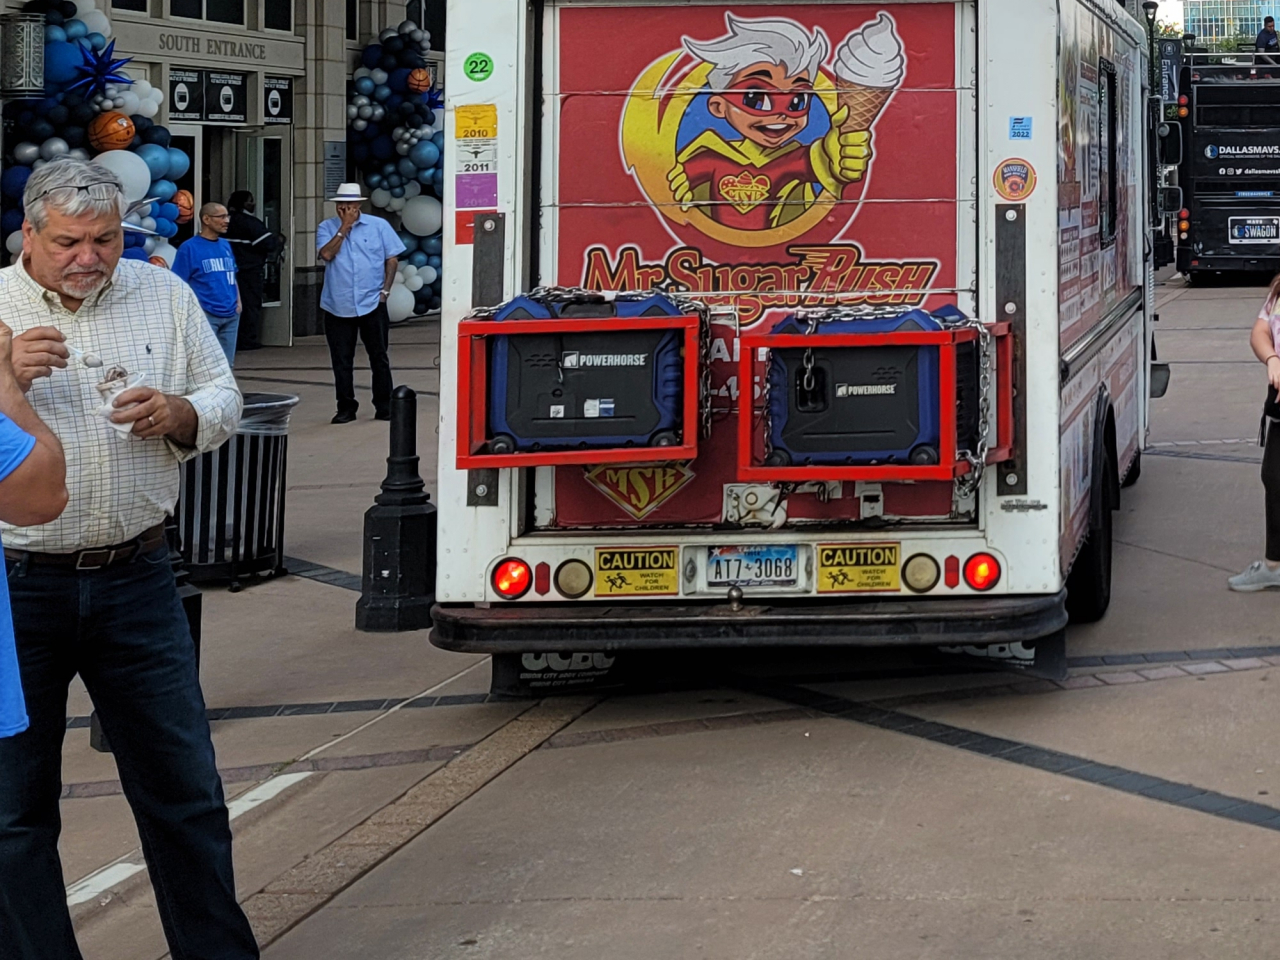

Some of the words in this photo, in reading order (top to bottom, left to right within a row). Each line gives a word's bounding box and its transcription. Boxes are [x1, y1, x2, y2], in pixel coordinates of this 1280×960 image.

[159, 33, 200, 53] SOUTH
[206, 39, 266, 60] ENTRANCE
[469, 59, 489, 74] 22
[1161, 59, 1171, 101] Entrance
[463, 129, 488, 138] 2010
[464, 163, 490, 172] 2011
[1244, 225, 1277, 238] SWAGON
[667, 247, 810, 325] Sugar
[580, 353, 648, 367] POWERHORSE
[848, 383, 897, 395] POWERHORSE
[600, 552, 674, 569] CAUTION
[822, 548, 896, 566] CAUTION
[714, 558, 742, 580] AT7
[754, 557, 792, 579] 3068
